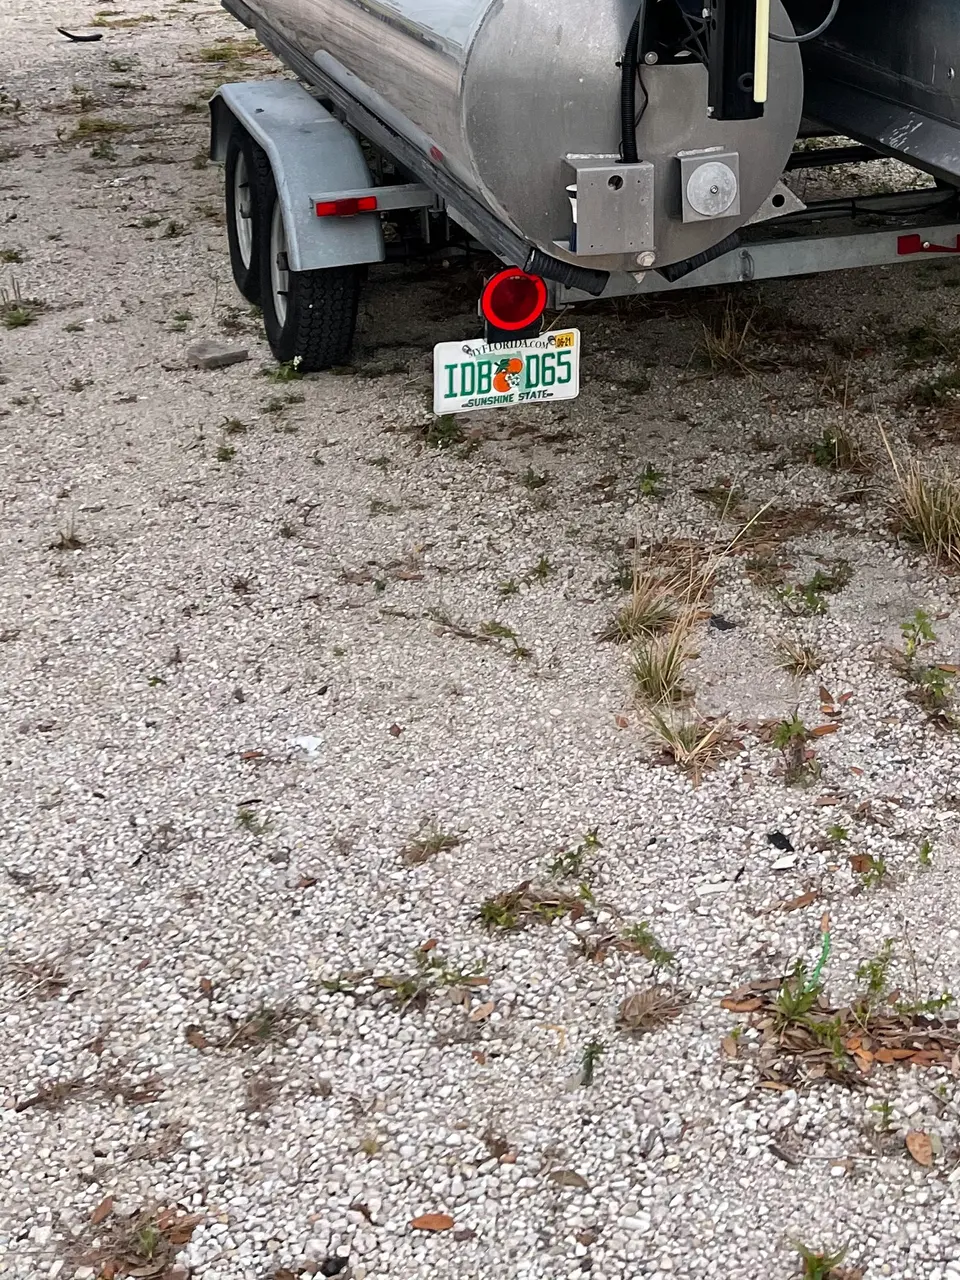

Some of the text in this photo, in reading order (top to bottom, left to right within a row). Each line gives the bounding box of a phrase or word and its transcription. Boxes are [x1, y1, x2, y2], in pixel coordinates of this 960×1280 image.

[444, 349, 572, 399] IDB D65
[467, 389, 548, 407] SUNSHINE STATE
